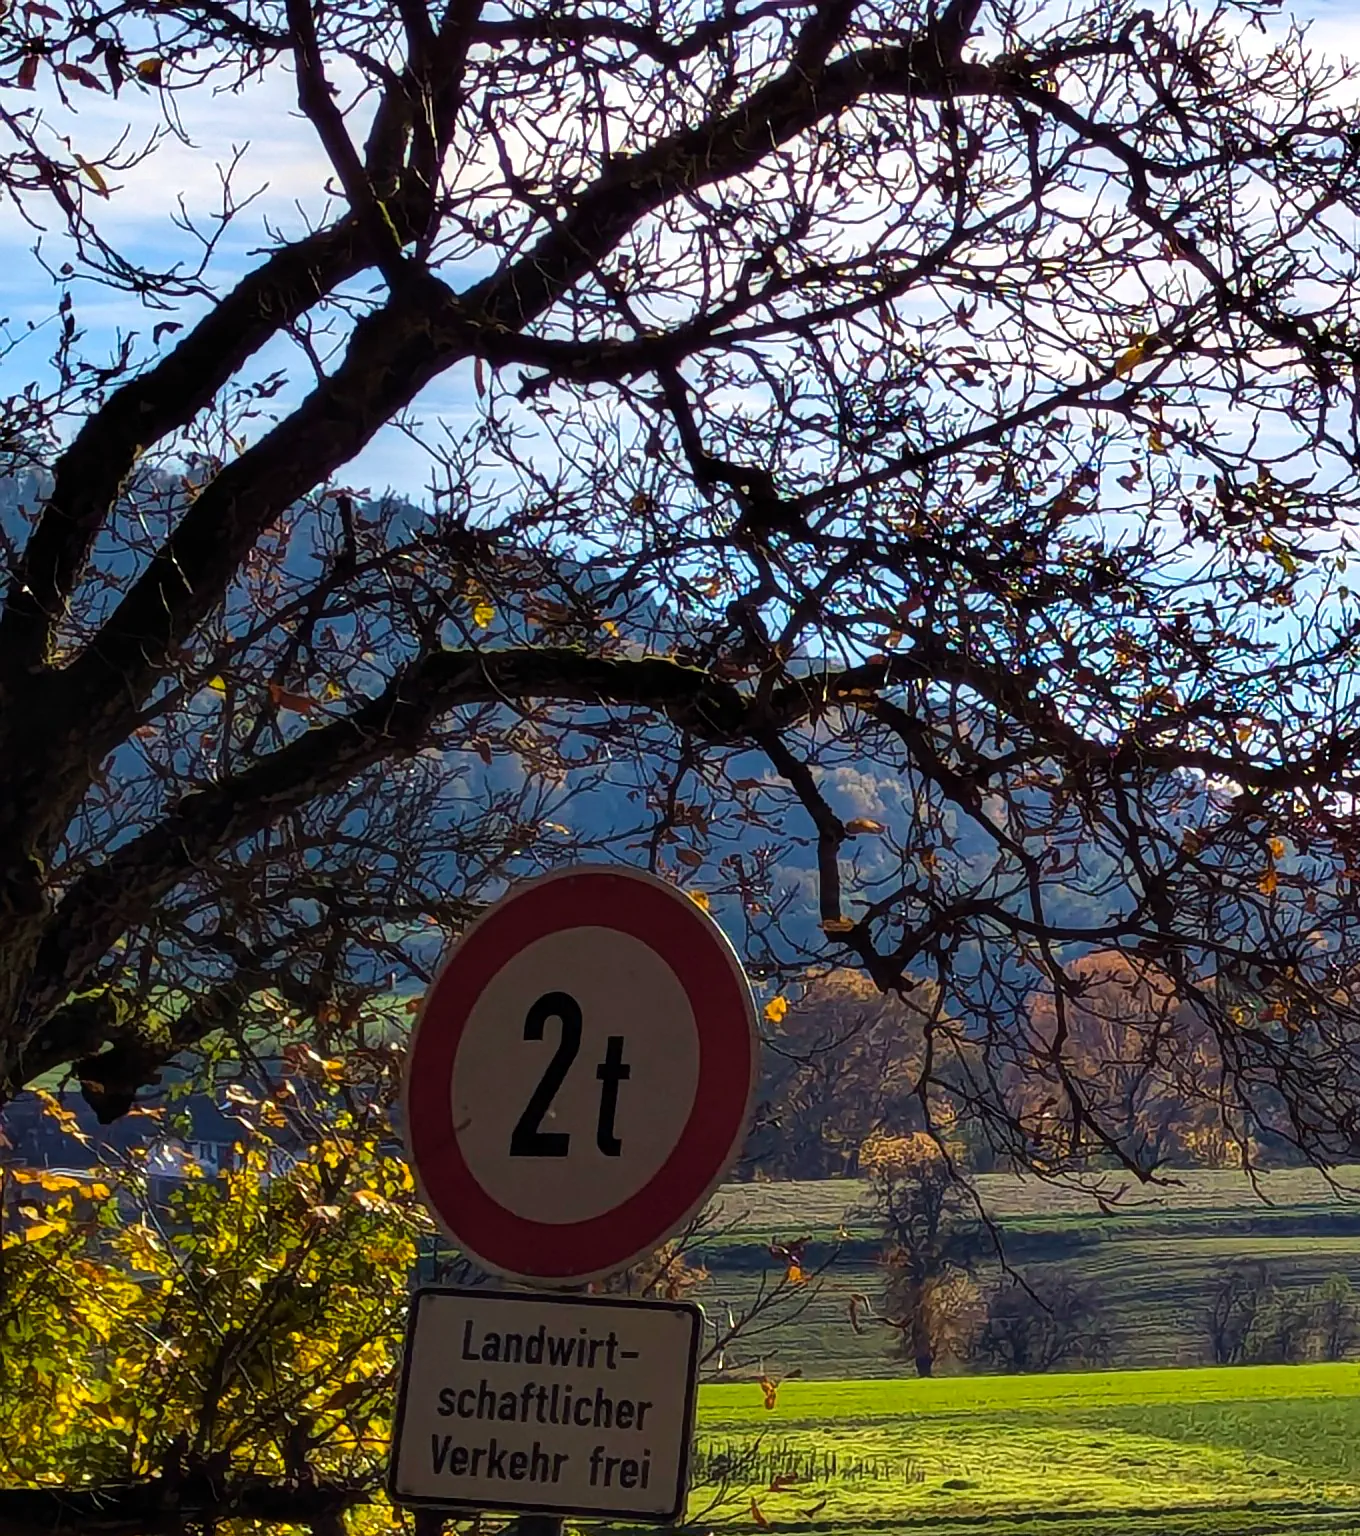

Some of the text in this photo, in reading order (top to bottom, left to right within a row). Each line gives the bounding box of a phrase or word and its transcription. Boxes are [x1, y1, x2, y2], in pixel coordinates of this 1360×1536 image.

[461, 1319, 639, 1370] Landwirt-
[437, 1380, 653, 1430] schaftlicher
[431, 1434, 651, 1489] Verkehr frei
